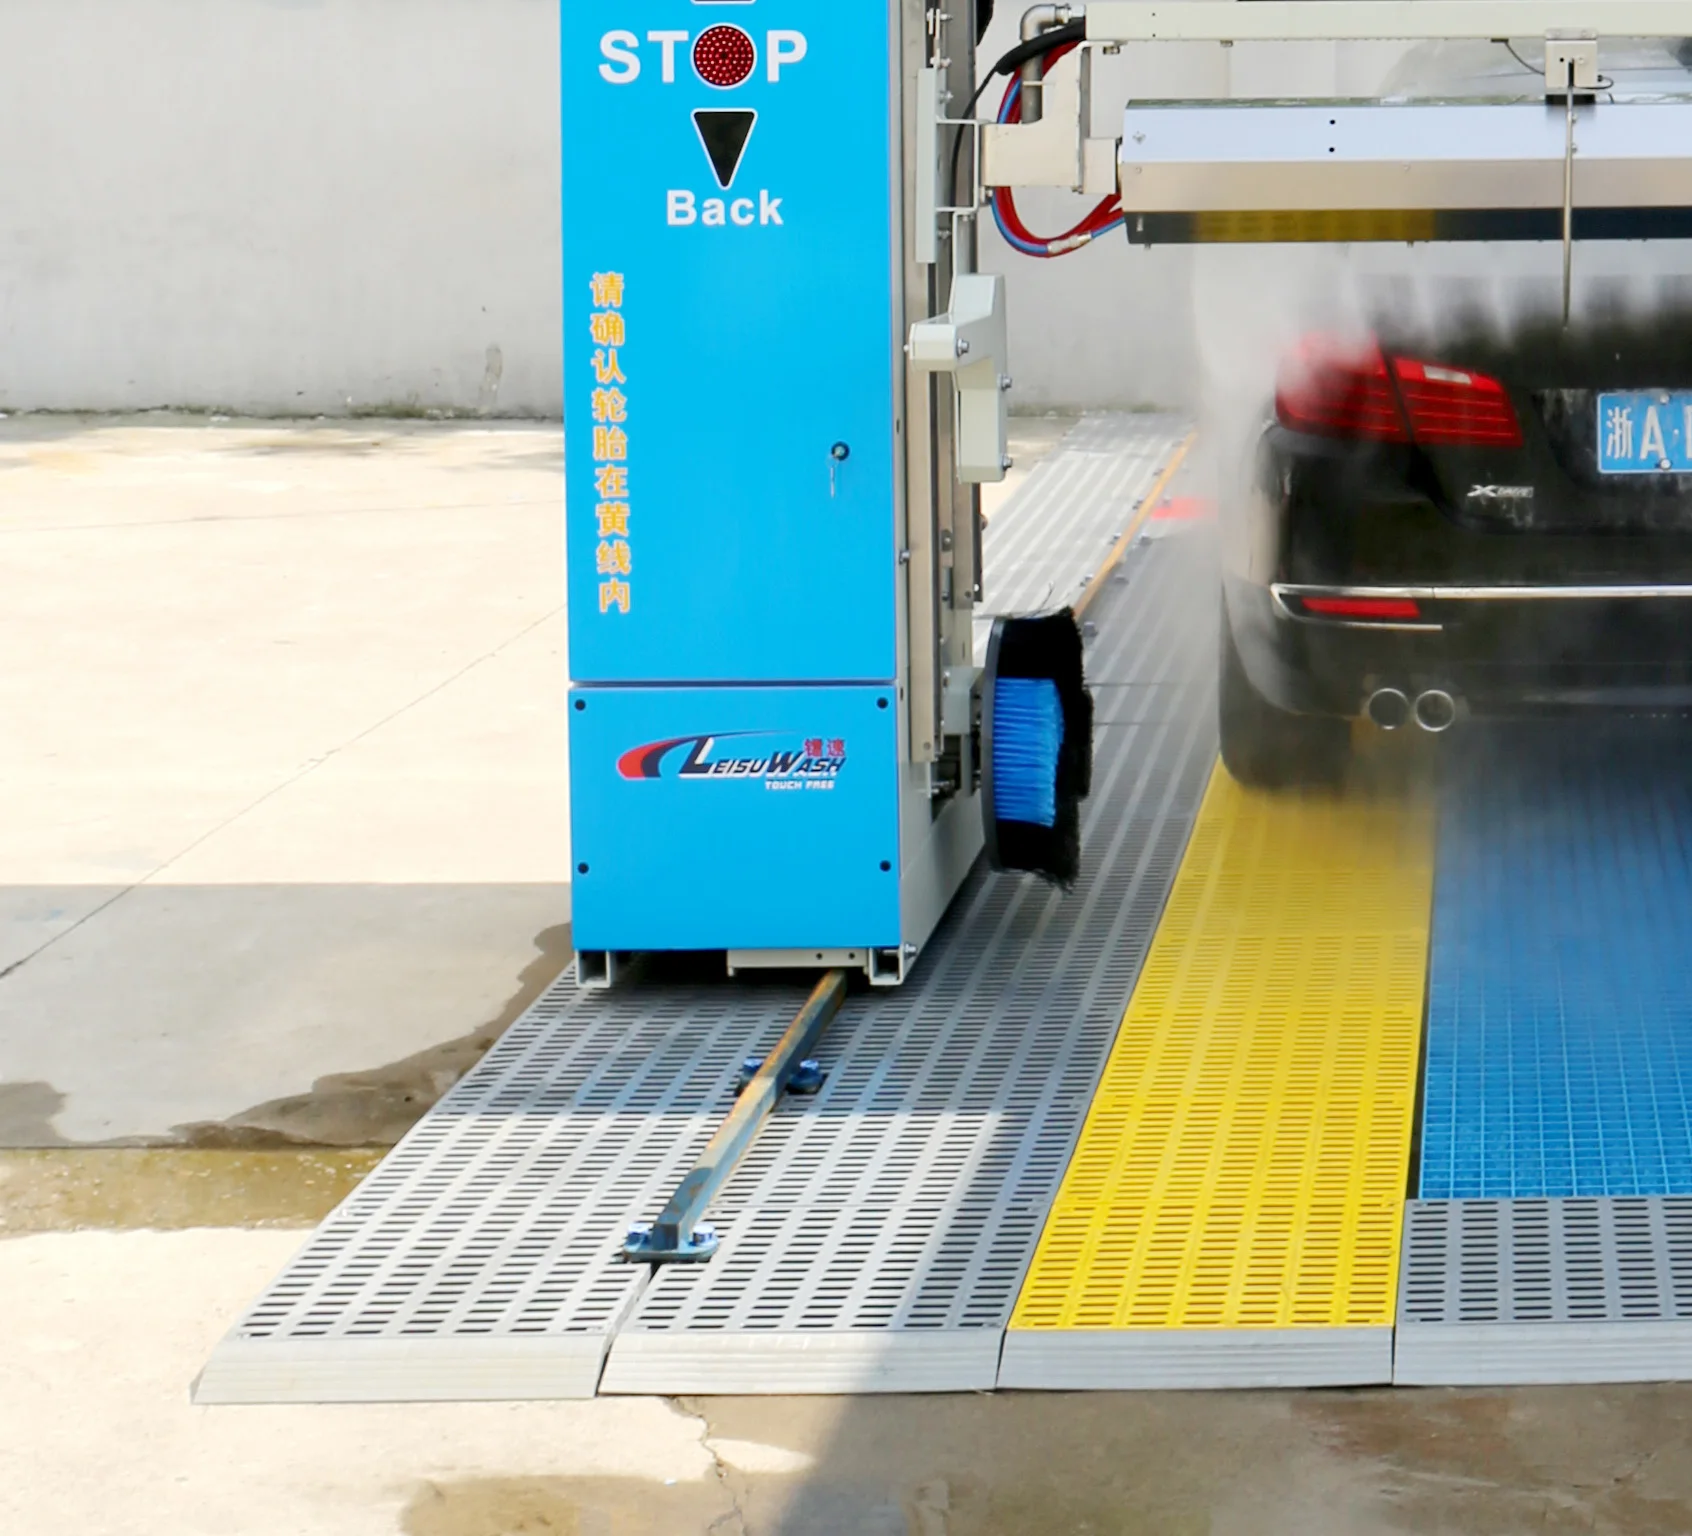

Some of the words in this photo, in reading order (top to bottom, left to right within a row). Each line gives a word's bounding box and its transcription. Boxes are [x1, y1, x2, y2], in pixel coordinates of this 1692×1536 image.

[665, 189, 784, 227] Back
[589, 271, 632, 615] 请确认轮胎在黄线内
